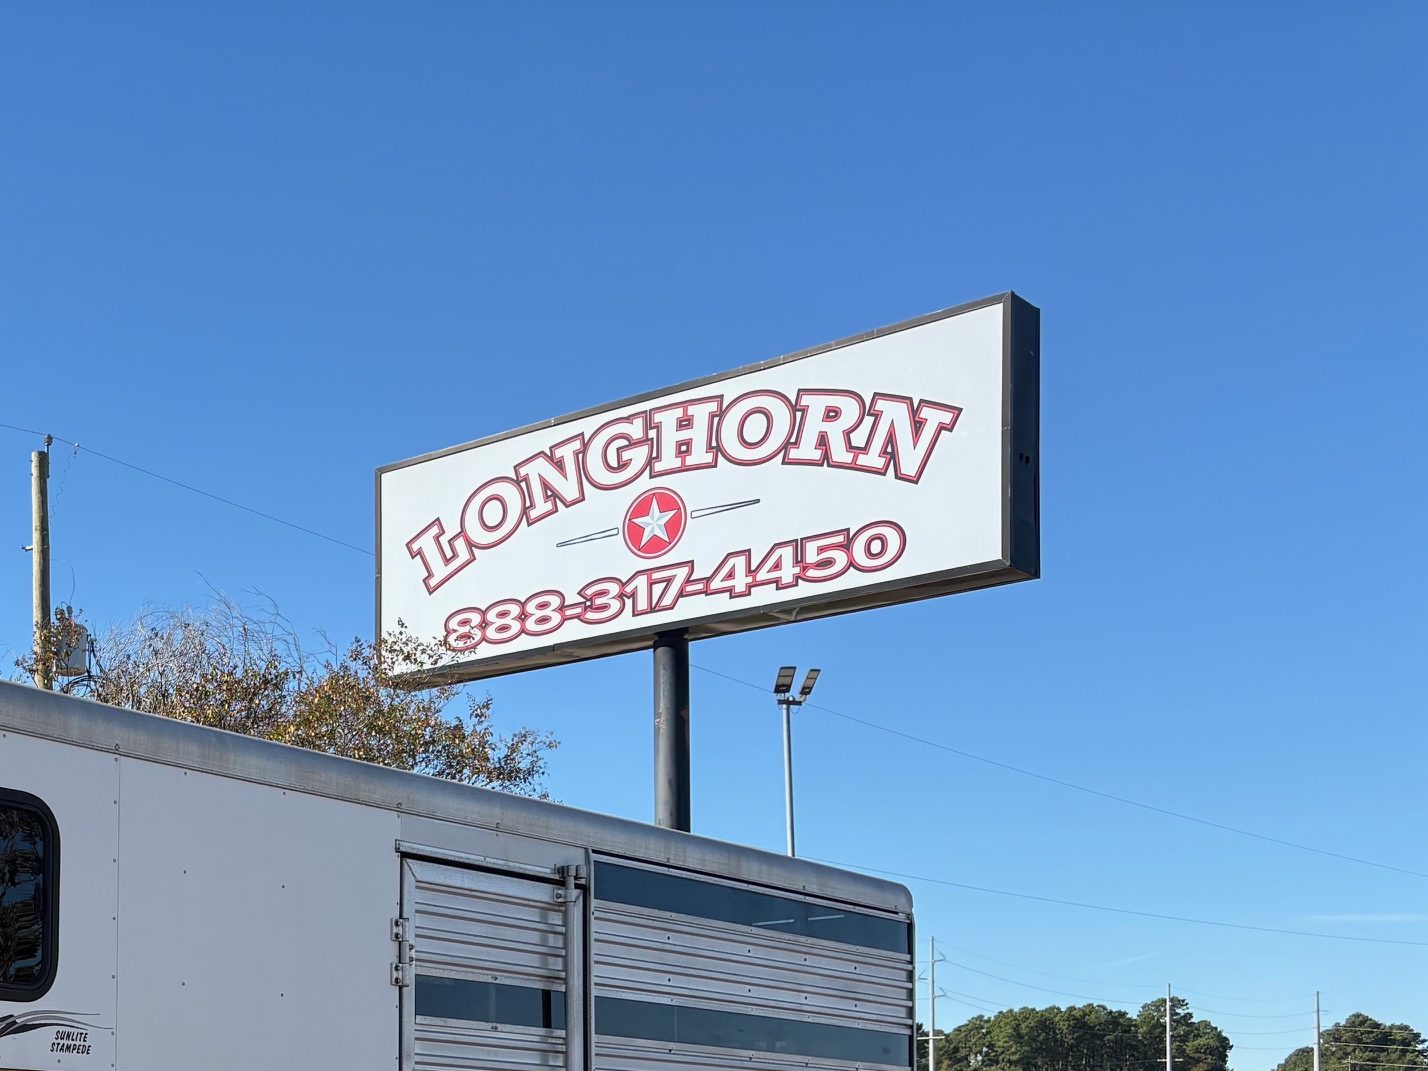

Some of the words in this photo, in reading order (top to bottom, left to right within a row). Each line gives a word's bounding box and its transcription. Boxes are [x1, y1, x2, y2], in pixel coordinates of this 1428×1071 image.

[406, 388, 963, 595] LONGHORN
[444, 520, 906, 652] 888-317-4450
[50, 1042, 91, 1055] STAMPEDE
[54, 1030, 88, 1042] SUNLITE
